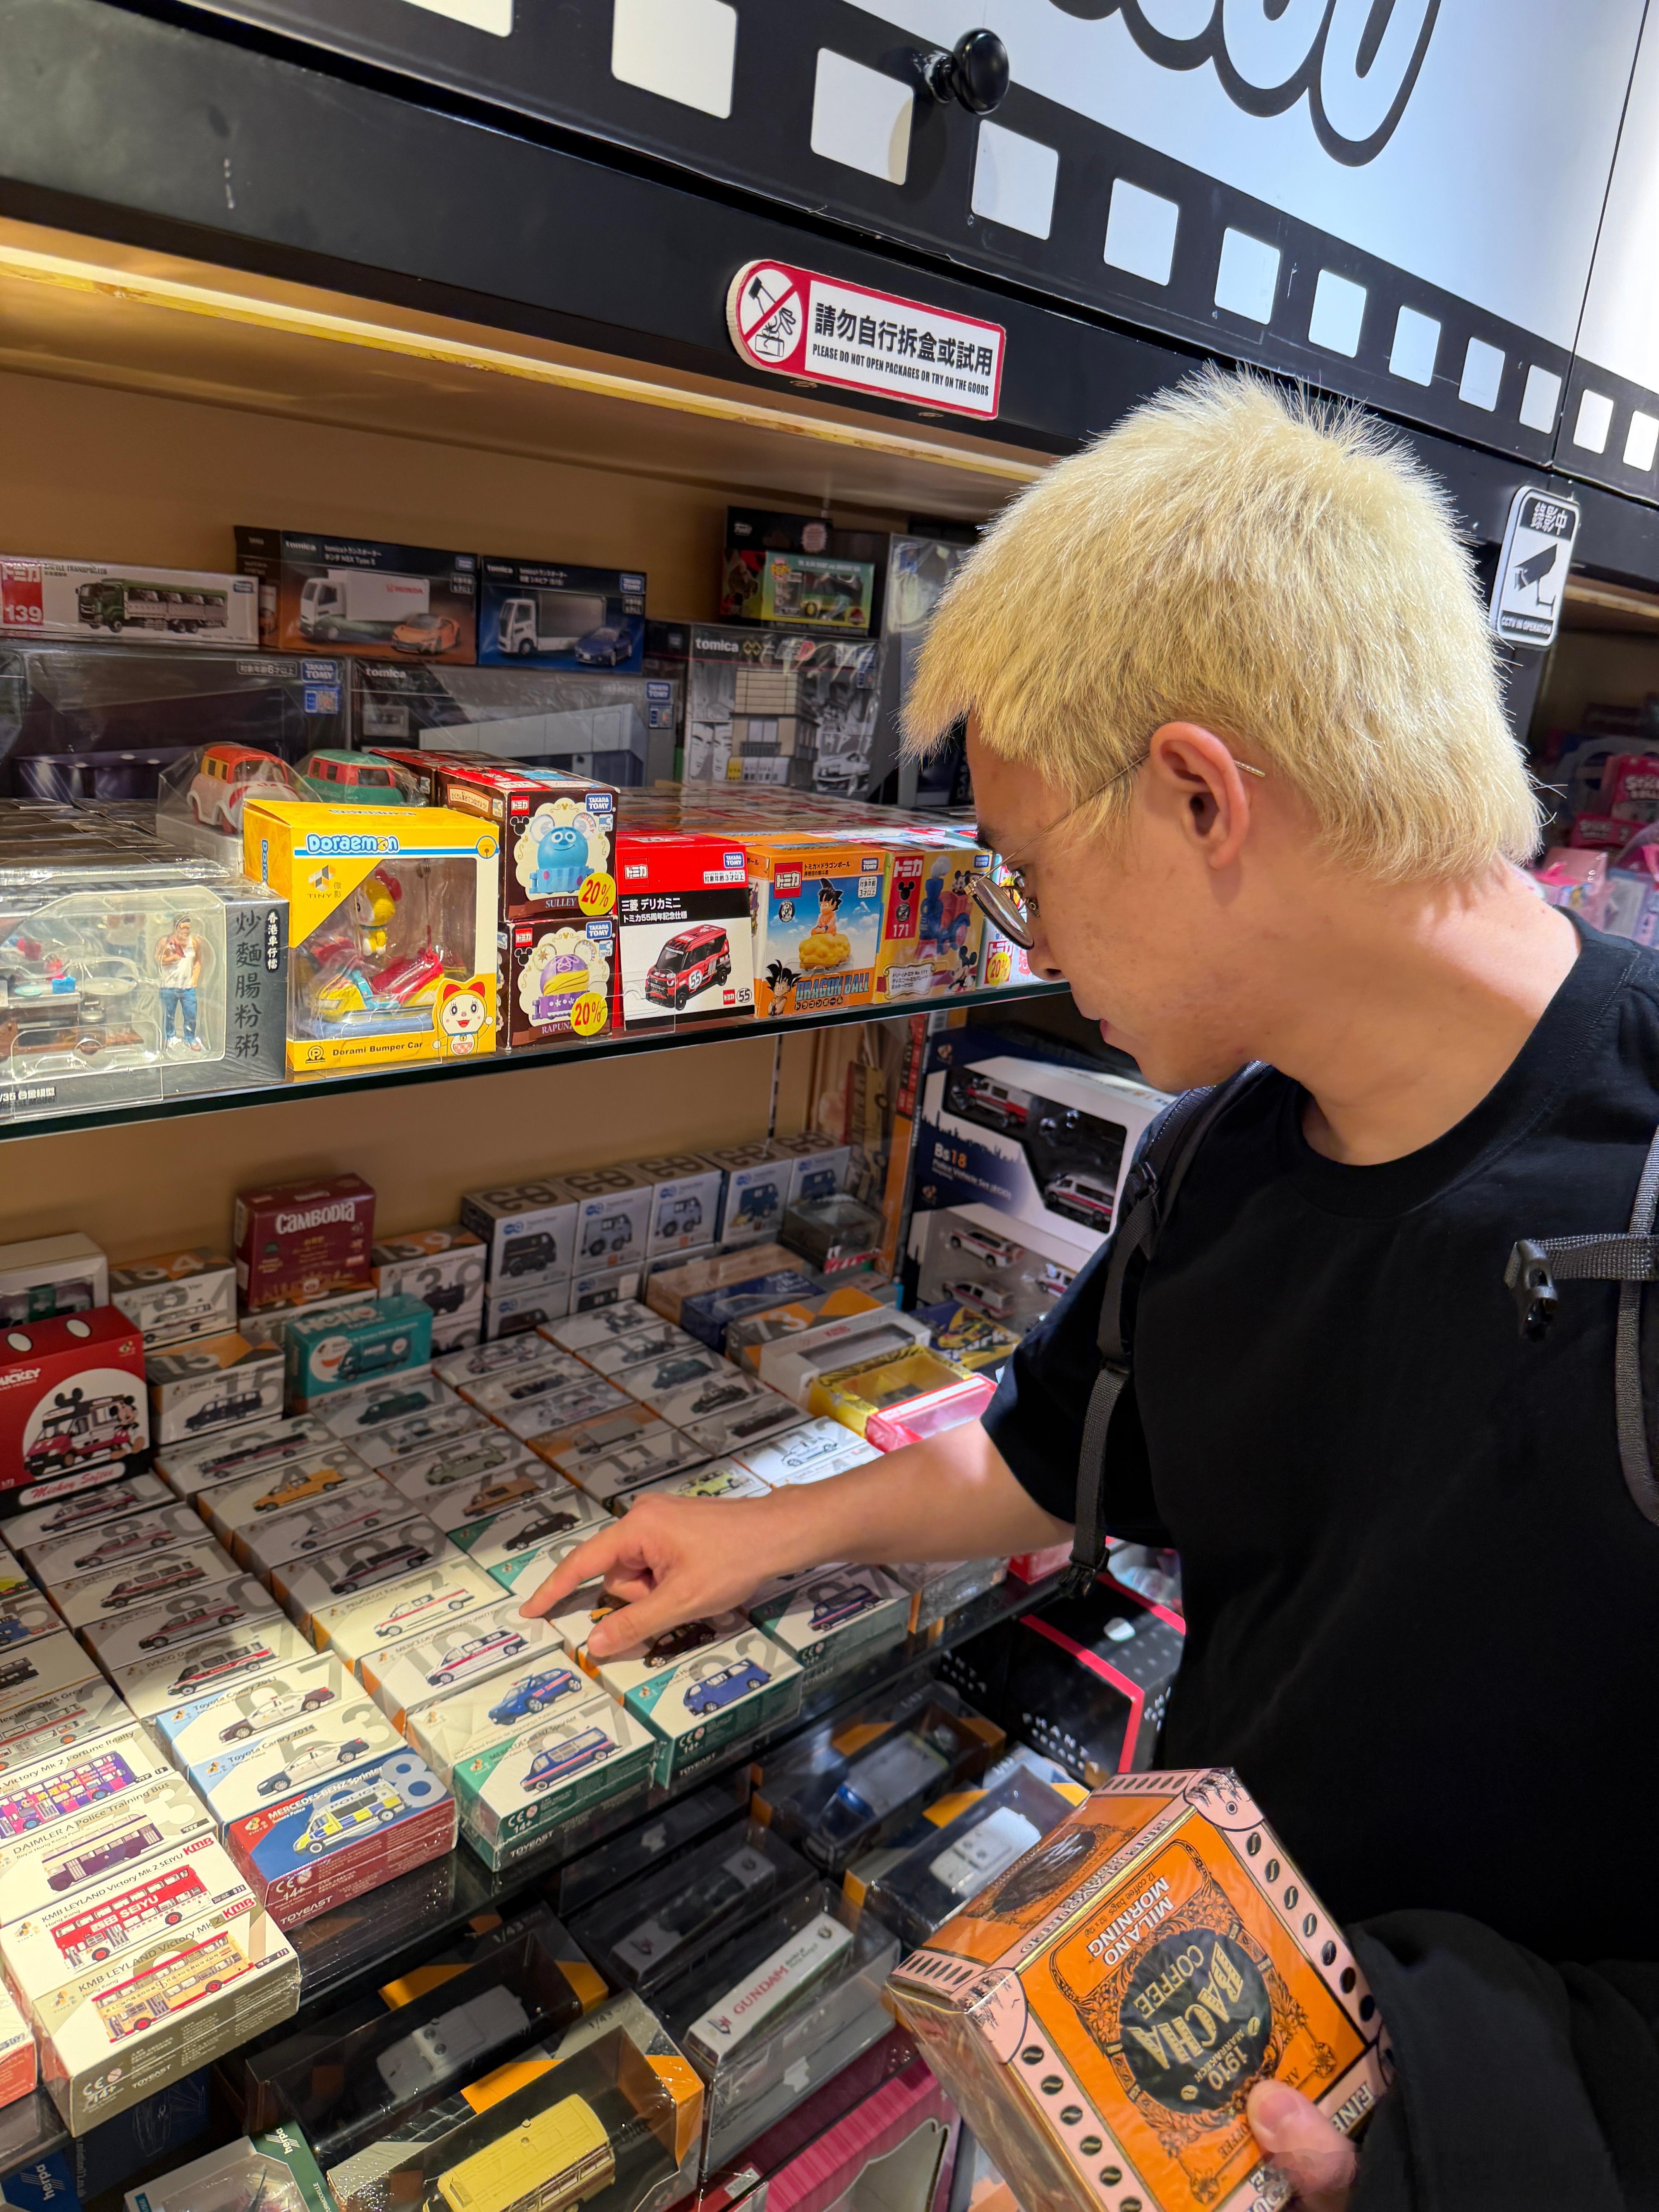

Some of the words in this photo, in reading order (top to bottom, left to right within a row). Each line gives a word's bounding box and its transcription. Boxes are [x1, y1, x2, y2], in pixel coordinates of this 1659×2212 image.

[815, 302, 993, 377] 請勿自行拆盒或試用
[812, 343, 838, 360] PLEASE
[840, 350, 849, 363] DO
[851, 353, 865, 366] NOT
[866, 357, 884, 371] OPEN
[885, 361, 919, 380] PACKAGES
[921, 370, 930, 382] OR
[932, 373, 944, 385] TRY
[945, 376, 953, 388] ON
[955, 378, 967, 391] THE
[968, 382, 989, 396] GOODS
[1530, 502, 1568, 535] 錄影中
[285, 541, 316, 552] tomica
[395, 586, 424, 594] HONDA
[5, 604, 43, 623] 139
[696, 637, 738, 653] tomica
[304, 663, 333, 672] TAKARA
[305, 671, 333, 680] TOMY
[365, 666, 407, 679] tomica
[512, 802, 528, 810] トミカ
[579, 814, 594, 833] SULLEY
[307, 835, 398, 853] Doraemon
[625, 865, 648, 878] トミカ
[893, 859, 923, 878] トミカ
[776, 871, 801, 889] トミカ
[546, 898, 576, 908] SULLEY
[581, 879, 611, 907] 20%
[621, 899, 639, 912] 三菱
[641, 897, 681, 910] デリカミニ
[516, 933, 532, 942] トミカ
[893, 924, 909, 937] 171
[689, 970, 701, 988] 55
[991, 959, 1008, 979] 20%
[235, 910, 262, 1059] 炒麵腸粉粥
[795, 975, 843, 1002] DRAGON
[843, 972, 869, 995] BALL
[739, 989, 750, 1001] 55
[795, 996, 843, 1011] ドラゴンボール
[574, 1001, 601, 1026] 20%
[542, 1022, 572, 1034] RAPUN
[332, 1047, 367, 1056] Dorami
[369, 1044, 404, 1054] Bumper
[407, 1041, 423, 1049] Car
[0, 1092, 16, 1103] /35
[934, 1142, 967, 1169] Bs18
[38, 1695, 60, 1708] DMS
[61, 1686, 84, 1700] Grey
[193, 1697, 225, 1712] Toyota
[2, 1770, 38, 1787] Victory
[41, 1763, 57, 1772] Mk
[65, 1744, 104, 1762] Fortune
[105, 1731, 135, 1746] Realty
[227, 1747, 261, 1764] Toyota
[261, 1734, 291, 1750] Camry
[348, 1766, 383, 1784] Sprinter
[12, 1828, 64, 1855] DAIMLER
[66, 1824, 75, 1832] A
[76, 1810, 107, 1827] Police
[107, 1791, 151, 1813] Training
[151, 1782, 170, 1793] Bus
[508, 1809, 524, 1827] CE
[513, 1819, 532, 1834] 14+
[16, 1849, 32, 1860] Royal
[33, 1842, 51, 1853] Hong
[51, 1834, 68, 1845] Kong
[182, 1837, 215, 1856] KMB
[1125, 1819, 1171, 1856] FINE
[276, 1877, 295, 1893] CE
[1146, 1871, 1157, 1883] 12
[41, 1907, 64, 1923] KMB
[63, 1887, 106, 1916] LEYLAND
[106, 1874, 137, 1894] Victory
[137, 1868, 153, 1878] Mk
[159, 1852, 184, 1869] SEIYU
[283, 1885, 306, 1901] 14+
[1125, 1880, 1147, 1899] coffee
[120, 1894, 159, 1919] SEIYU
[222, 1898, 256, 1918] KMB
[280, 1896, 333, 1925] TOYEAST
[1020, 1857, 1127, 1954] FLAVOURED
[1108, 1898, 1128, 1916] bags
[45, 1917, 64, 1929] Hong
[64, 1908, 81, 1920] Kong
[1086, 1877, 1170, 1957] MORNING
[1103, 1896, 1175, 1966] MILANO
[78, 1974, 105, 1992] KMB
[105, 1950, 156, 1980] LEYLAND
[158, 1931, 195, 1957] Victory
[196, 1921, 213, 1934] Mk
[82, 1987, 101, 1998] Hong
[101, 1978, 119, 1990] Kong
[733, 1964, 790, 2015] GUNDAM
[1133, 1944, 1204, 2020] COFFEE
[1126, 1941, 1244, 2070] BACHA
[1194, 2028, 1245, 2083] MARRAKECH
[1208, 2045, 1248, 2091] 1910
[82, 2076, 105, 2097] CE
[275, 2127, 293, 2155] herpa
[1218, 2121, 1250, 2160] OFFEE
[35, 2163, 56, 2202] herpa
